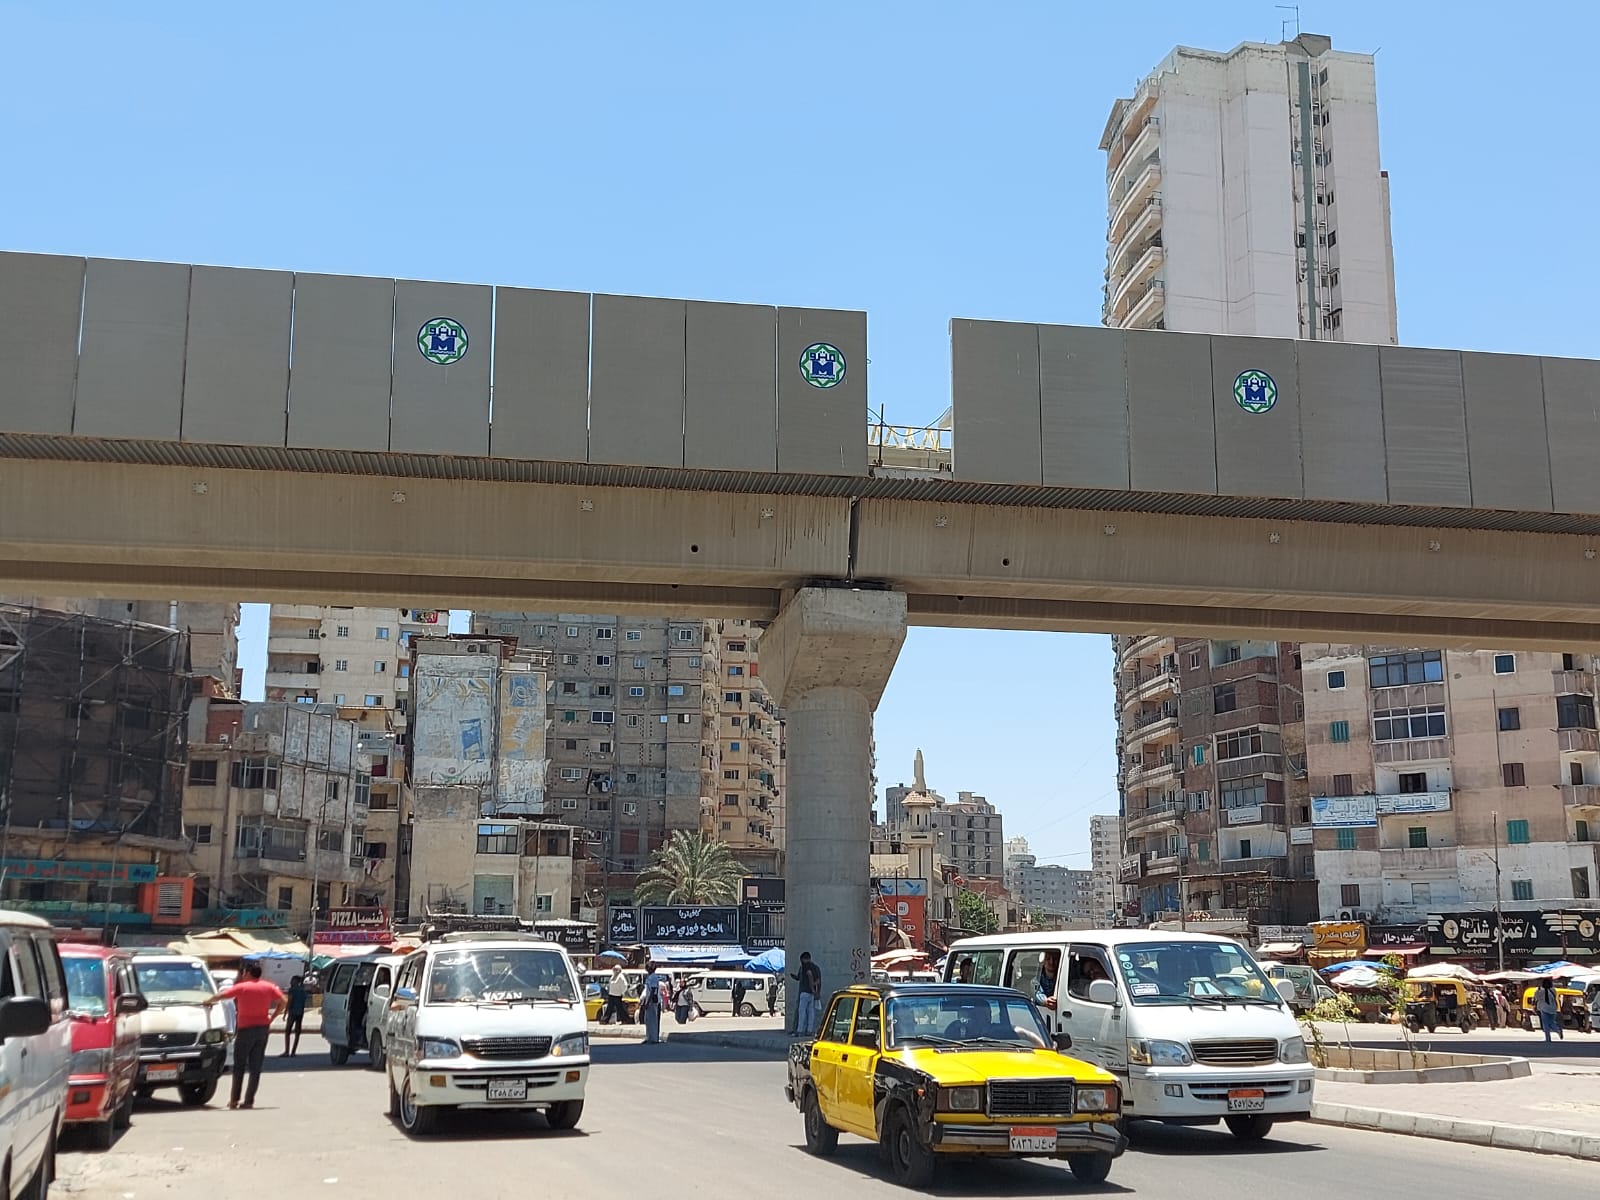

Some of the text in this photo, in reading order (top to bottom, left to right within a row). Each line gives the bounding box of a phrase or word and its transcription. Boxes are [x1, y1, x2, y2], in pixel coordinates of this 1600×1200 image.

[331, 911, 357, 927] PIZZA
[677, 923, 699, 937] فوزي
[700, 923, 724, 936] الحاج
[752, 938, 786, 947] SAMSUN
[1400, 934, 1415, 944] عيد
[483, 991, 523, 1001] YAZAN
